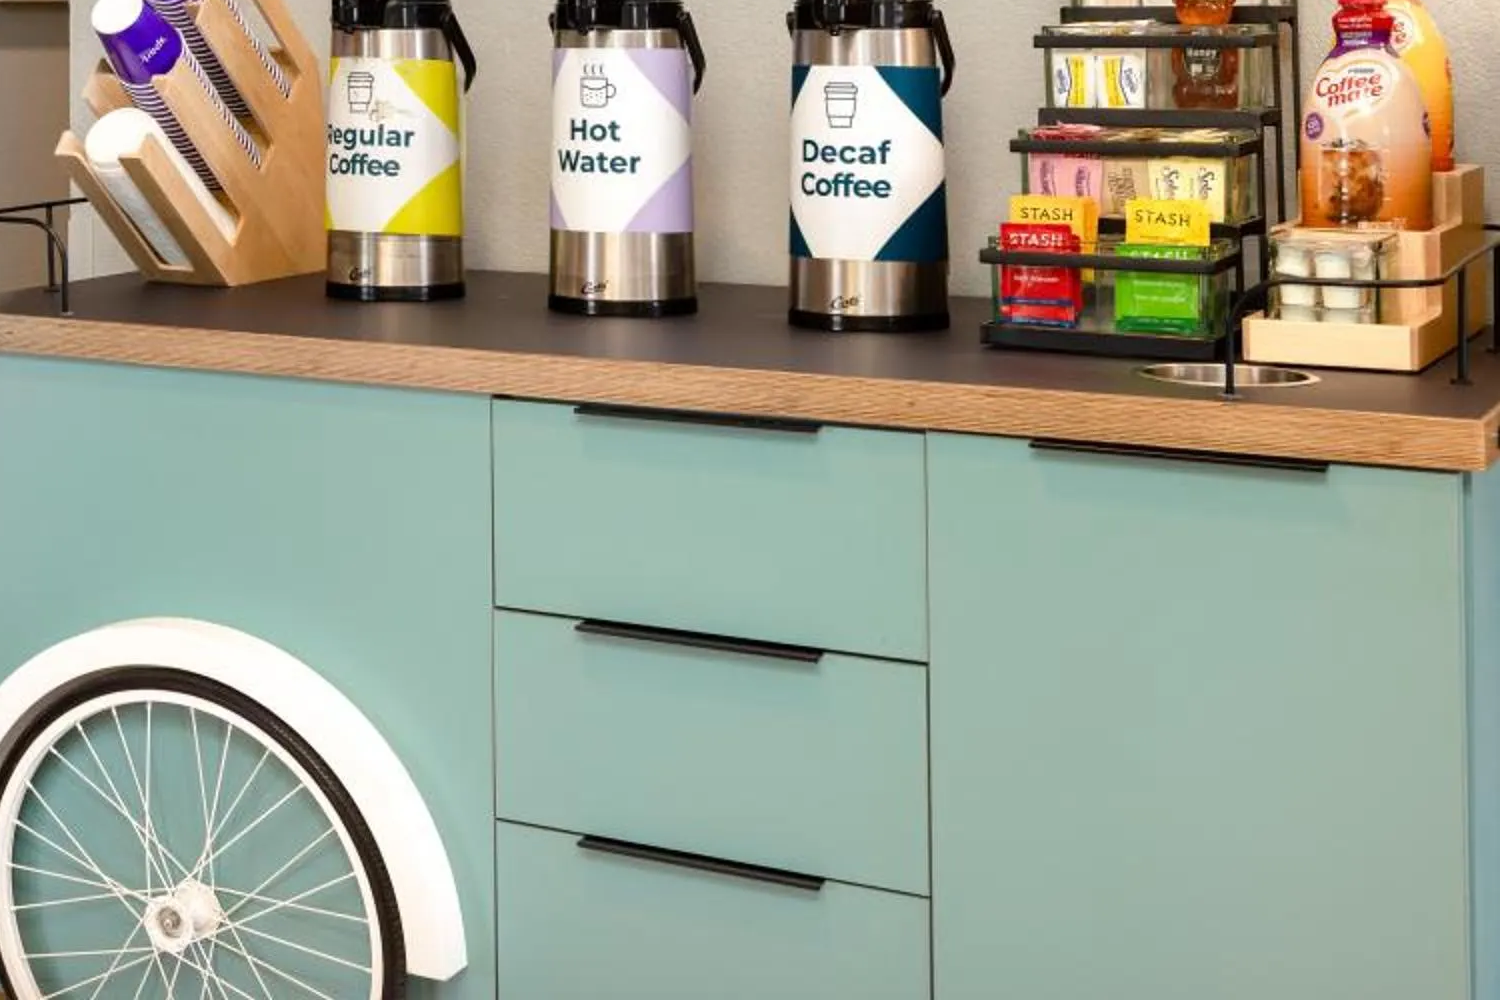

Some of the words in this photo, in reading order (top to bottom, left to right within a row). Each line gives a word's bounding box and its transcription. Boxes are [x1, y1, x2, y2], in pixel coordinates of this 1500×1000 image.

[569, 118, 622, 142] Hot
[557, 148, 641, 174] Water
[802, 139, 892, 165] Decaf
[329, 152, 402, 177] Coffee
[801, 171, 892, 199] Coffee
[1019, 207, 1074, 221] STASH
[1134, 209, 1191, 228] STASH
[1008, 232, 1064, 247] STASH
